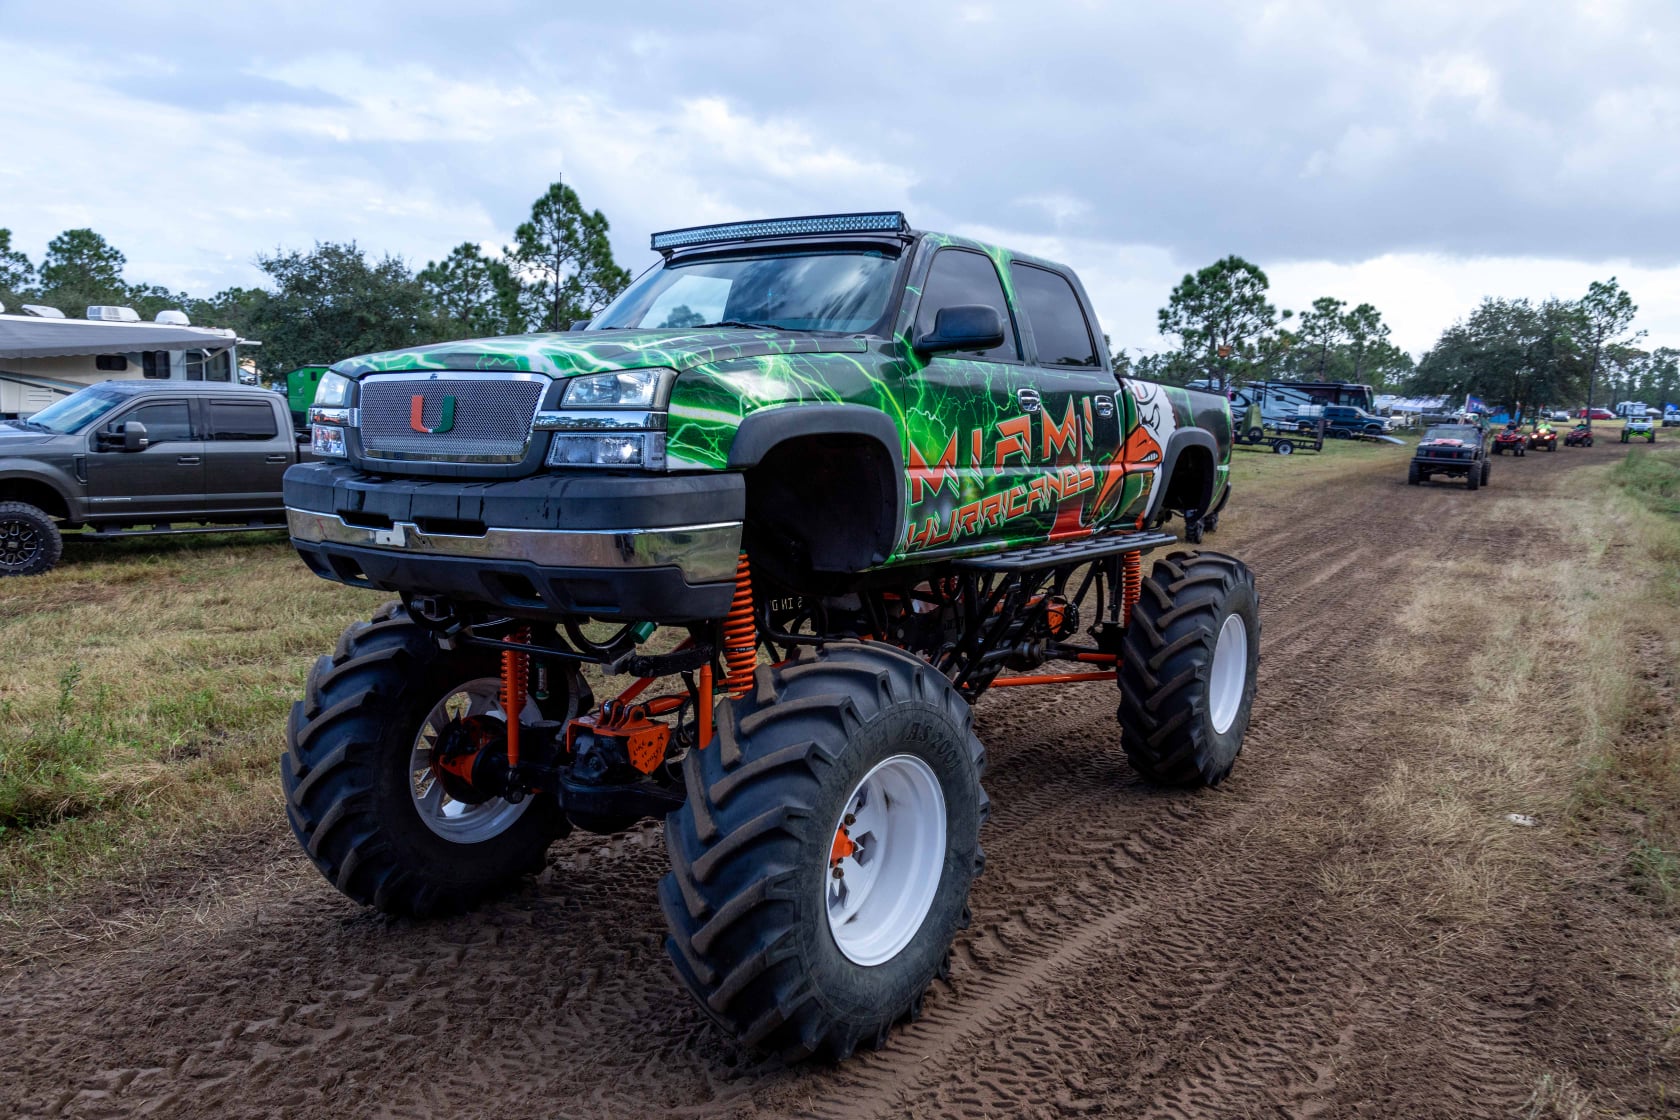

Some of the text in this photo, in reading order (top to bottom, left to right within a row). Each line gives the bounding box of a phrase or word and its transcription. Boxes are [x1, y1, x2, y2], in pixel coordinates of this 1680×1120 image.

[411, 394, 456, 433] U
[907, 393, 1094, 505] MIAMI
[902, 460, 1095, 552] HURRICANES
